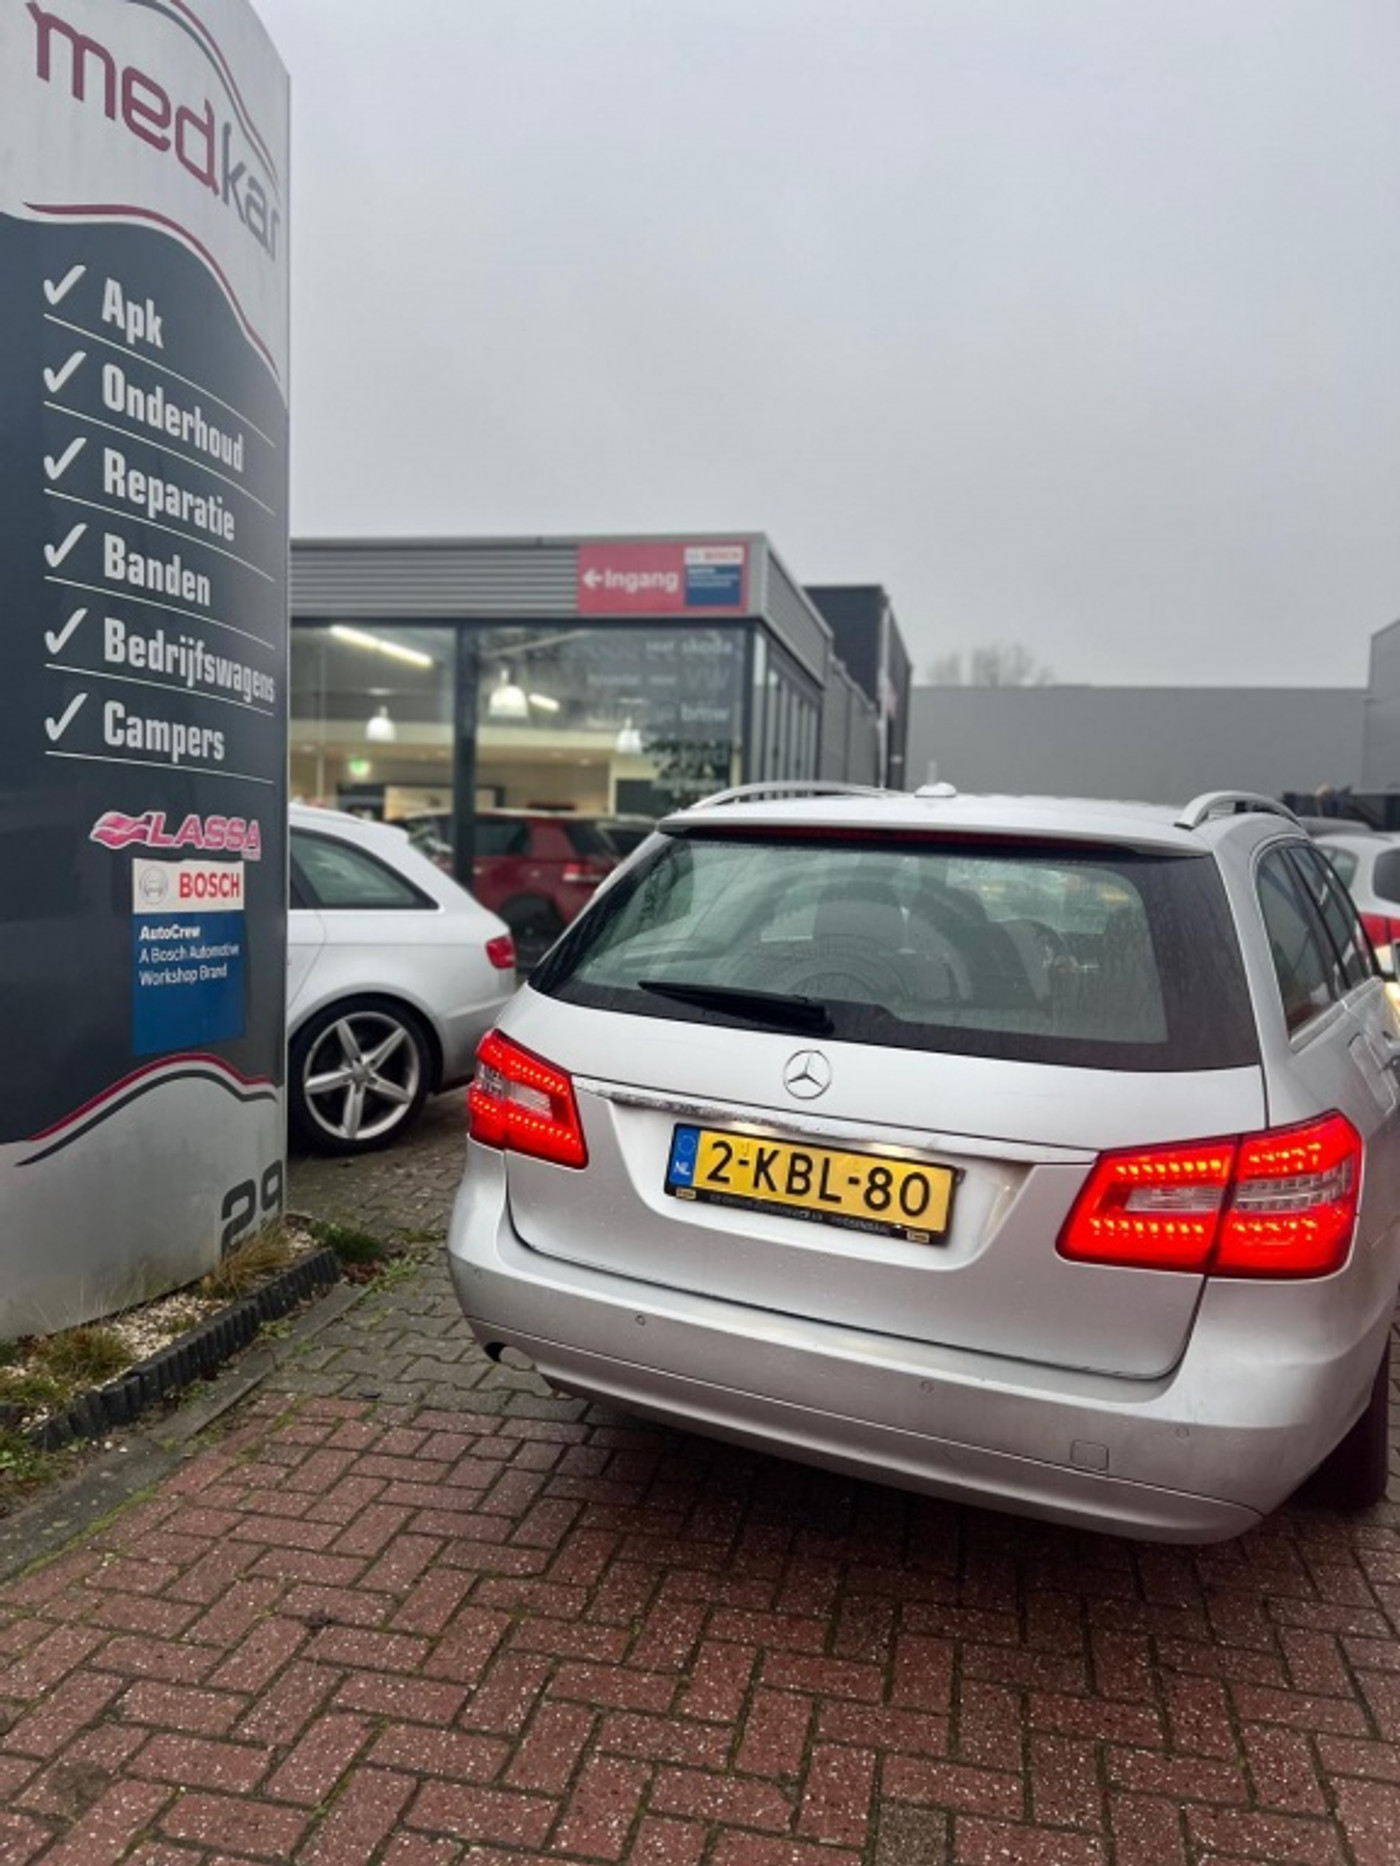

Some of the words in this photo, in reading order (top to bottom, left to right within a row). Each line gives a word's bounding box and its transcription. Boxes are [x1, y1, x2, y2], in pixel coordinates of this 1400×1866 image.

[102, 277, 163, 348] Apk
[103, 363, 243, 472] Onderhoud
[104, 447, 235, 540] Reparatie
[104, 533, 210, 606] Banden
[604, 569, 679, 594] Ingang
[104, 617, 275, 703] Bedrijfswagens
[104, 700, 225, 763] Campers
[150, 812, 260, 849] LASSA
[179, 872, 240, 899] BOSCH
[138, 947, 150, 964] A
[151, 945, 187, 962] Bosch
[139, 924, 201, 941] AutoCrew
[138, 967, 198, 986] Workshop
[199, 963, 228, 981] Brand
[221, 1159, 283, 1258] 29
[706, 1140, 931, 1218] 2-KBL-80
